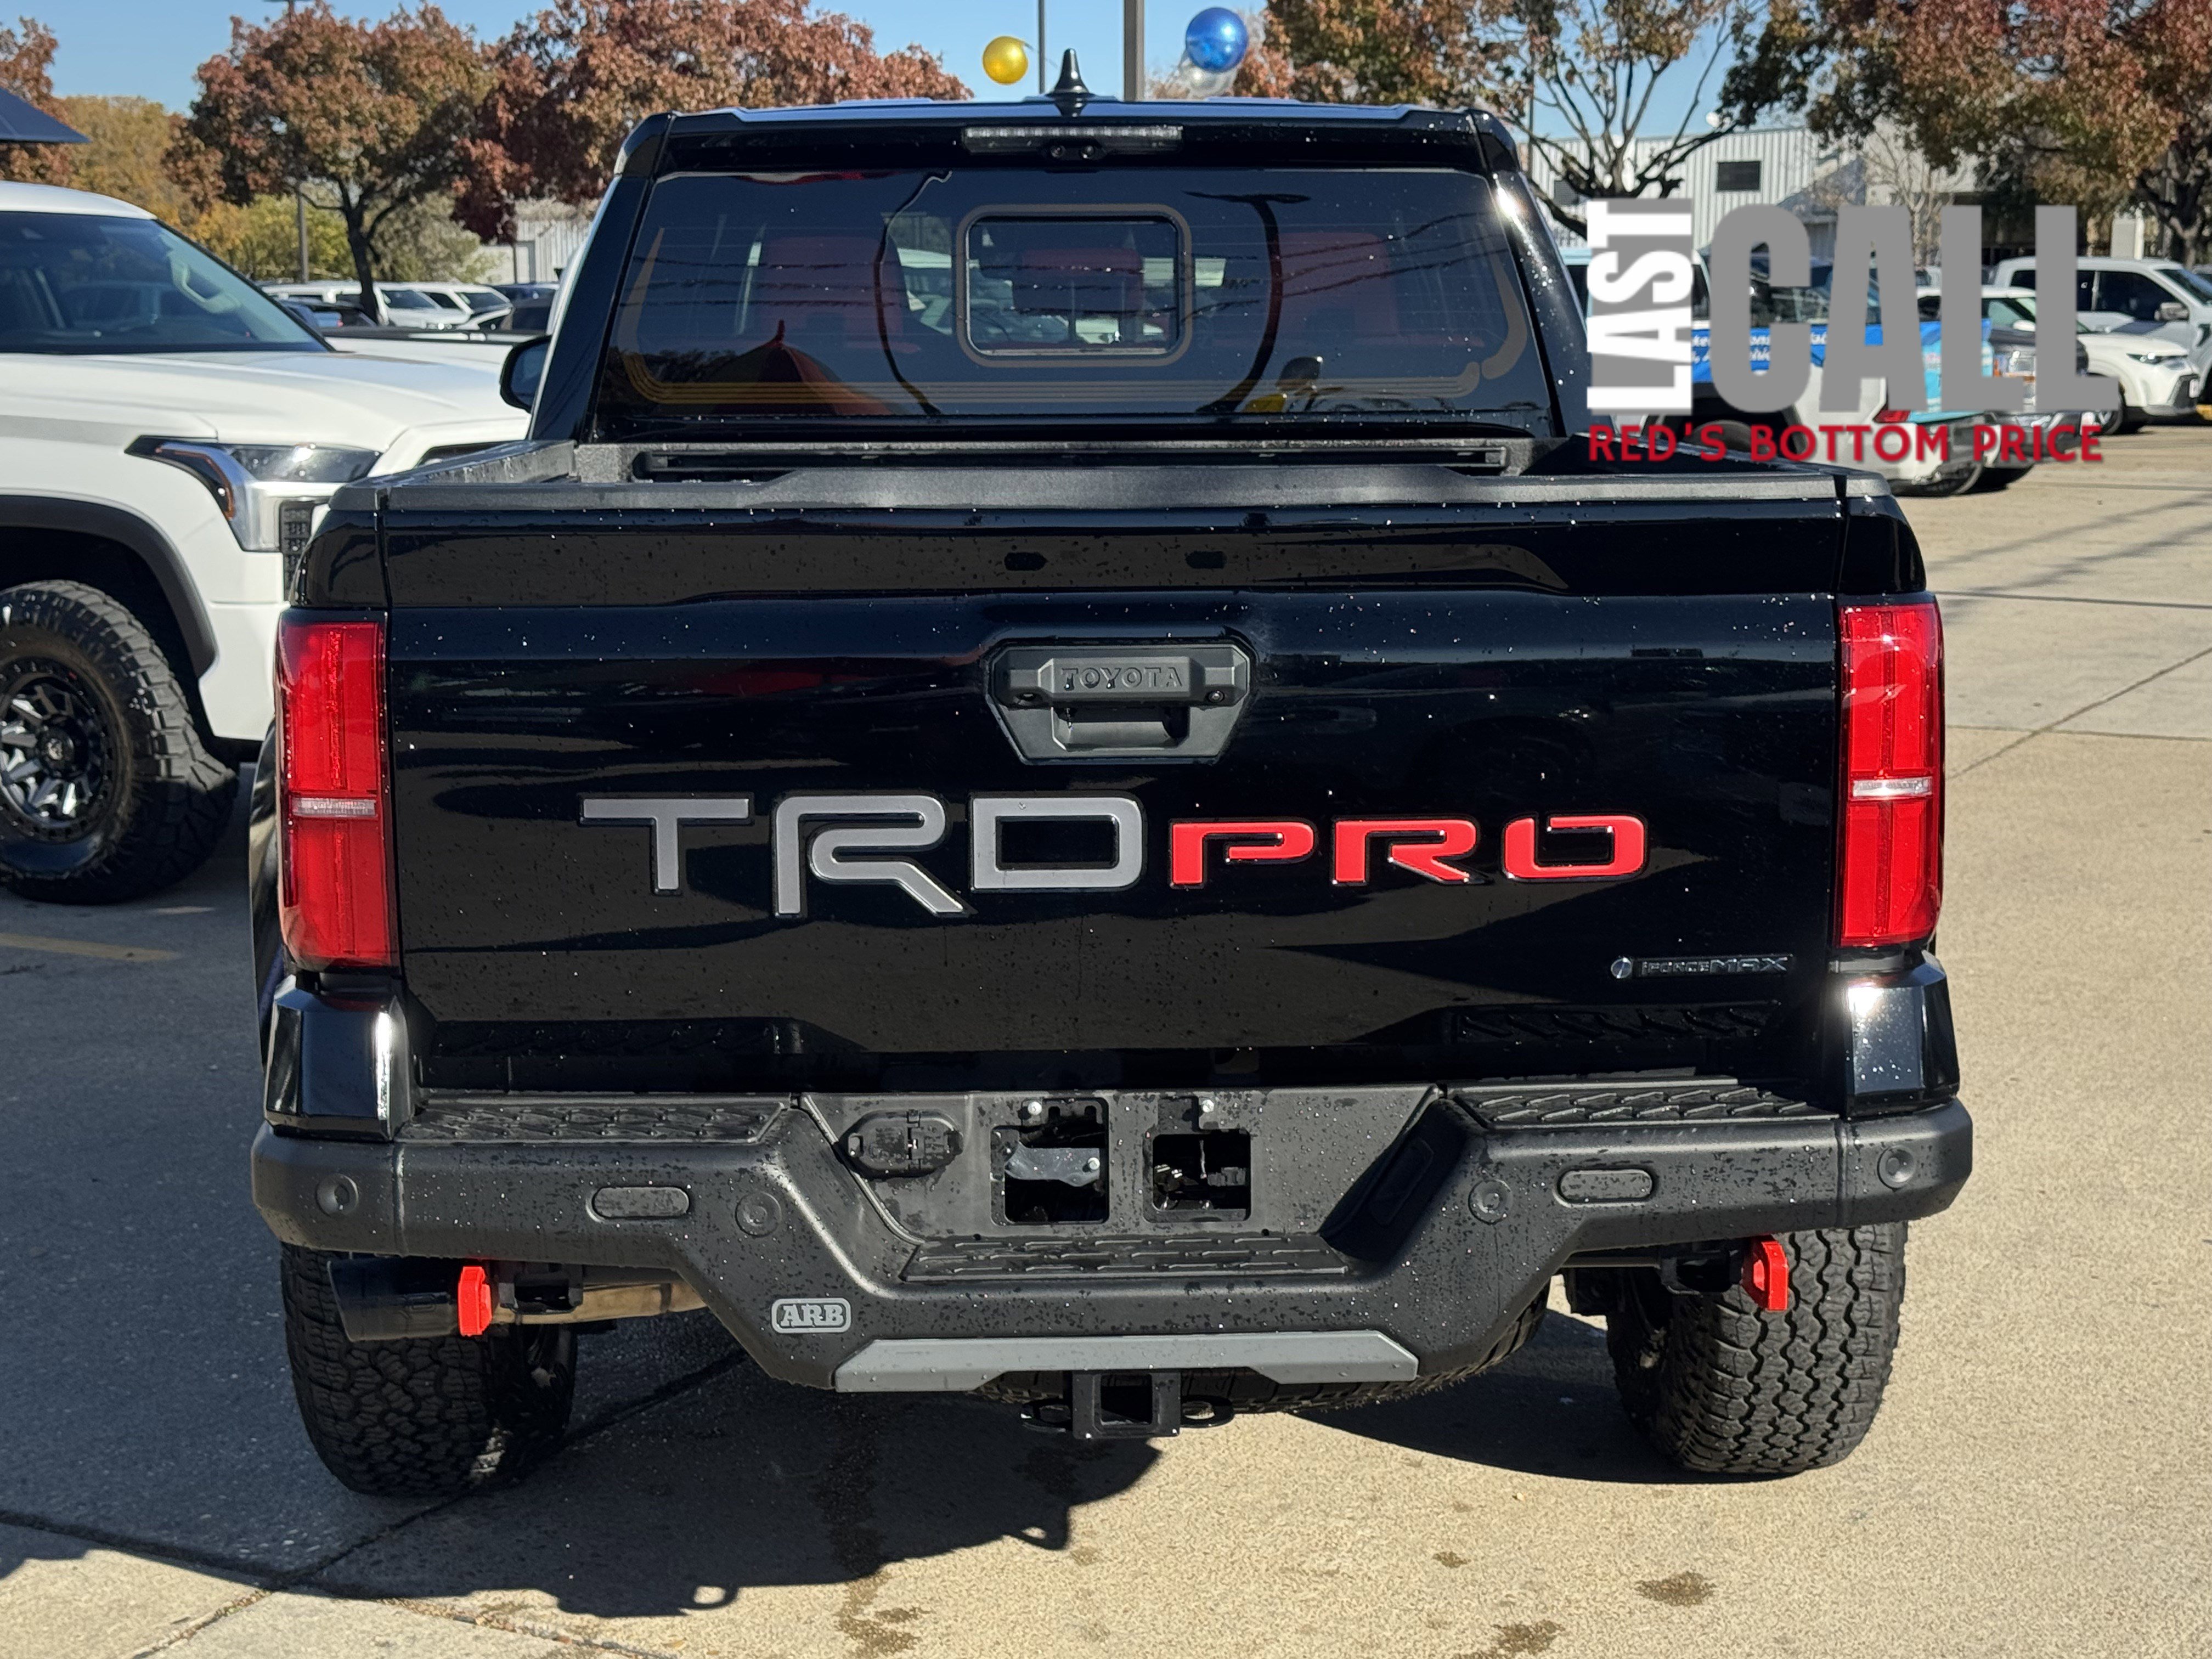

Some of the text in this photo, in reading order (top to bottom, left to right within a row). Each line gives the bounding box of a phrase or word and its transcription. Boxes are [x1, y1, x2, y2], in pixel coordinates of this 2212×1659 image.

[1062, 667, 1183, 690] TOYOTA
[582, 795, 1646, 915] TRD PRO
[780, 1304, 844, 1327] ARB
